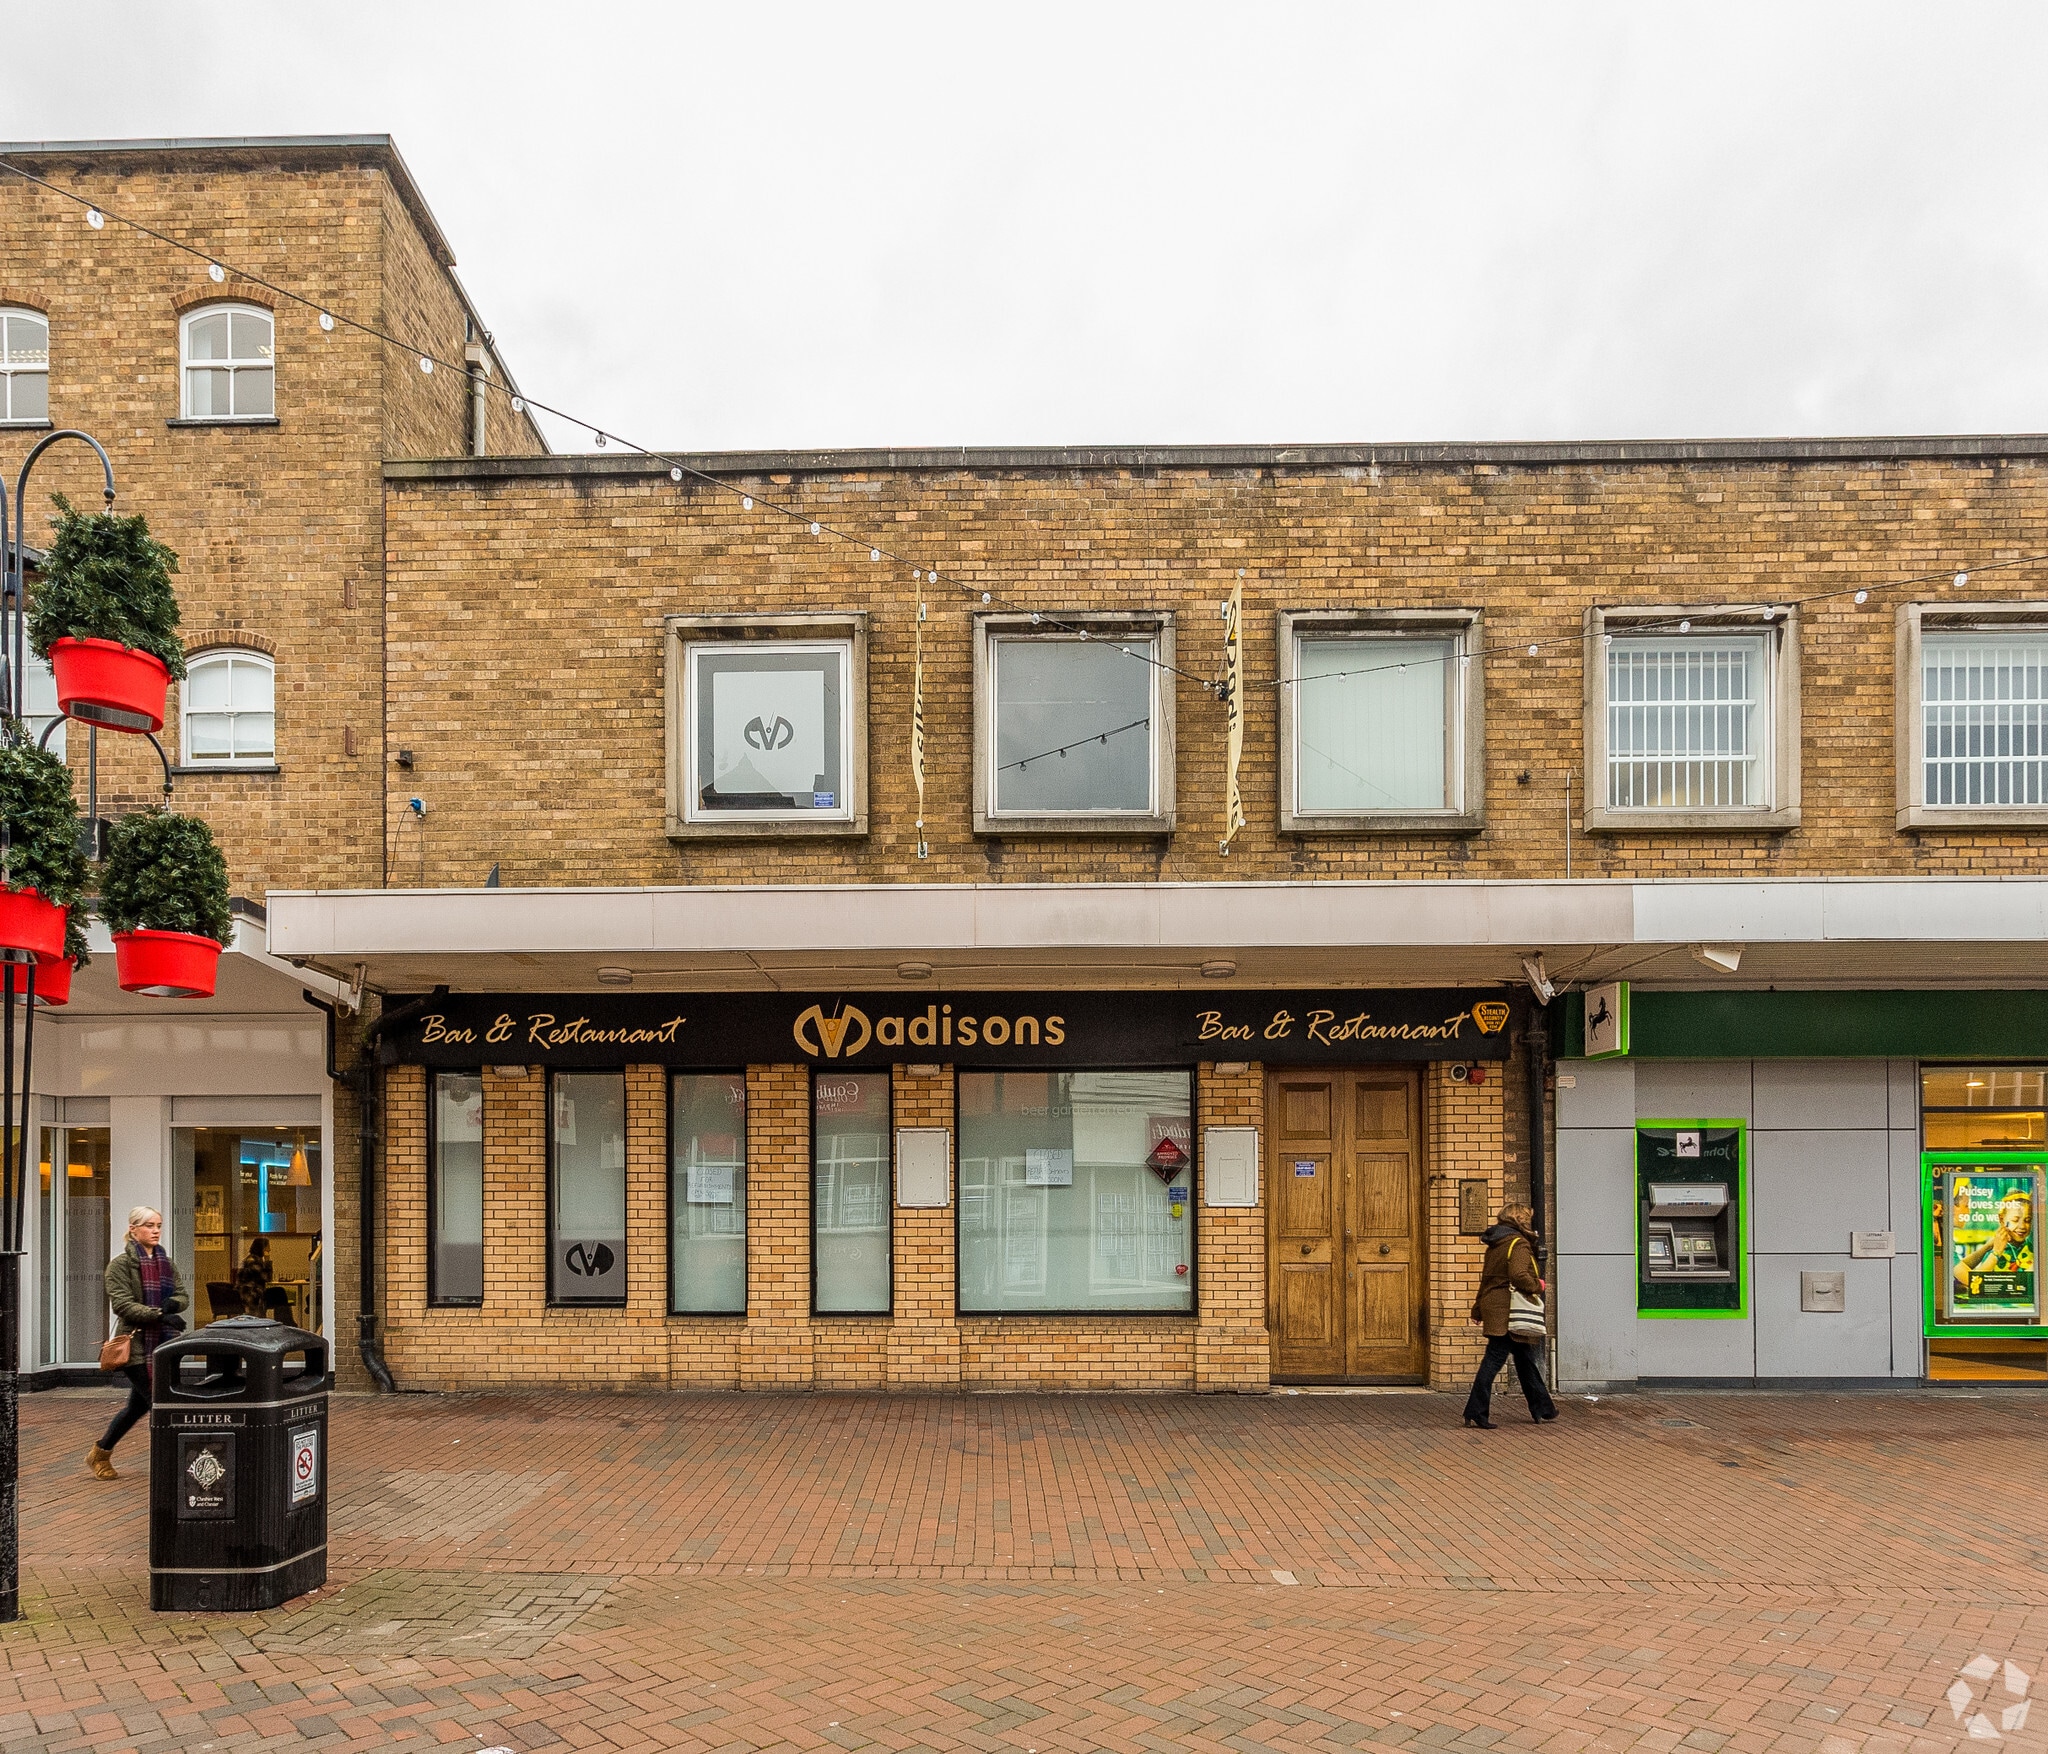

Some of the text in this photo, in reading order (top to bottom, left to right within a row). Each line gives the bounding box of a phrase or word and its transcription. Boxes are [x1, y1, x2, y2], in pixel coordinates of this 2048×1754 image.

[420, 1013, 687, 1050] Bar & Restaurant
[1196, 1010, 1471, 1046] Bar & Restaurant
[1958, 1186, 1994, 1199] Pudsey
[1968, 1199, 1994, 1210] loves
[1958, 1213, 1970, 1223] so
[1971, 1211, 1985, 1223] do
[291, 1404, 318, 1418] LITTER
[184, 1414, 232, 1424] LITTER
